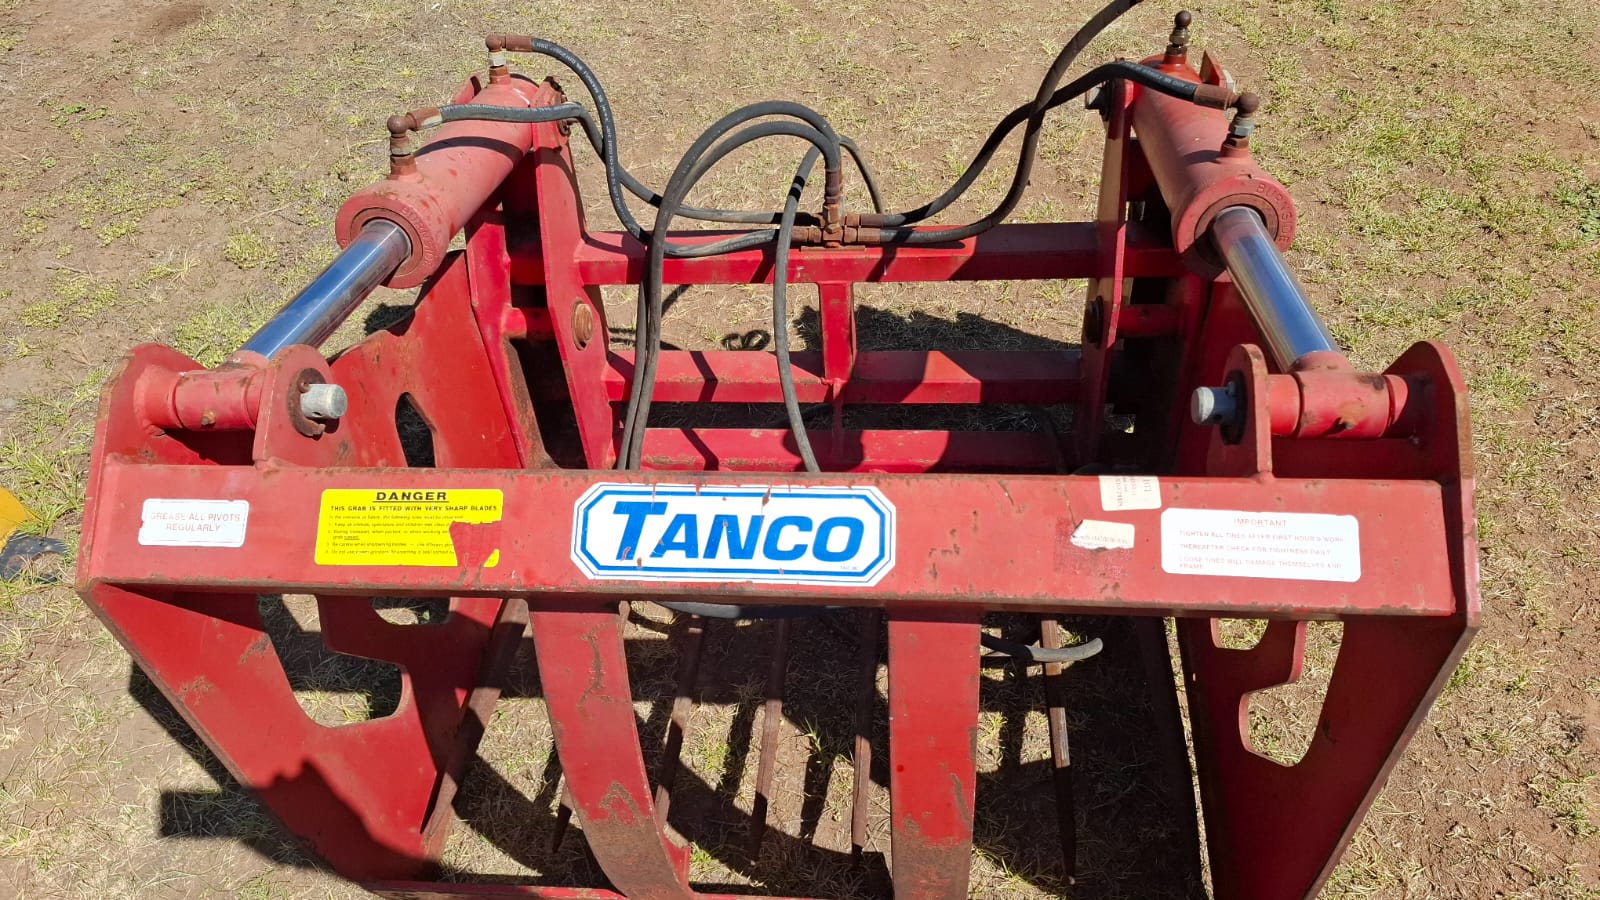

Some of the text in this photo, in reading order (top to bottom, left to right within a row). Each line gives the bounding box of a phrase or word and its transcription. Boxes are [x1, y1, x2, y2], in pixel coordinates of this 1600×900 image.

[376, 492, 448, 501] DANGER
[151, 512, 241, 522] GREASE ALL PIVOTS
[166, 523, 221, 532] REGULARLY
[1233, 518, 1287, 528] IMPORTANT
[612, 500, 865, 562] TANCO
